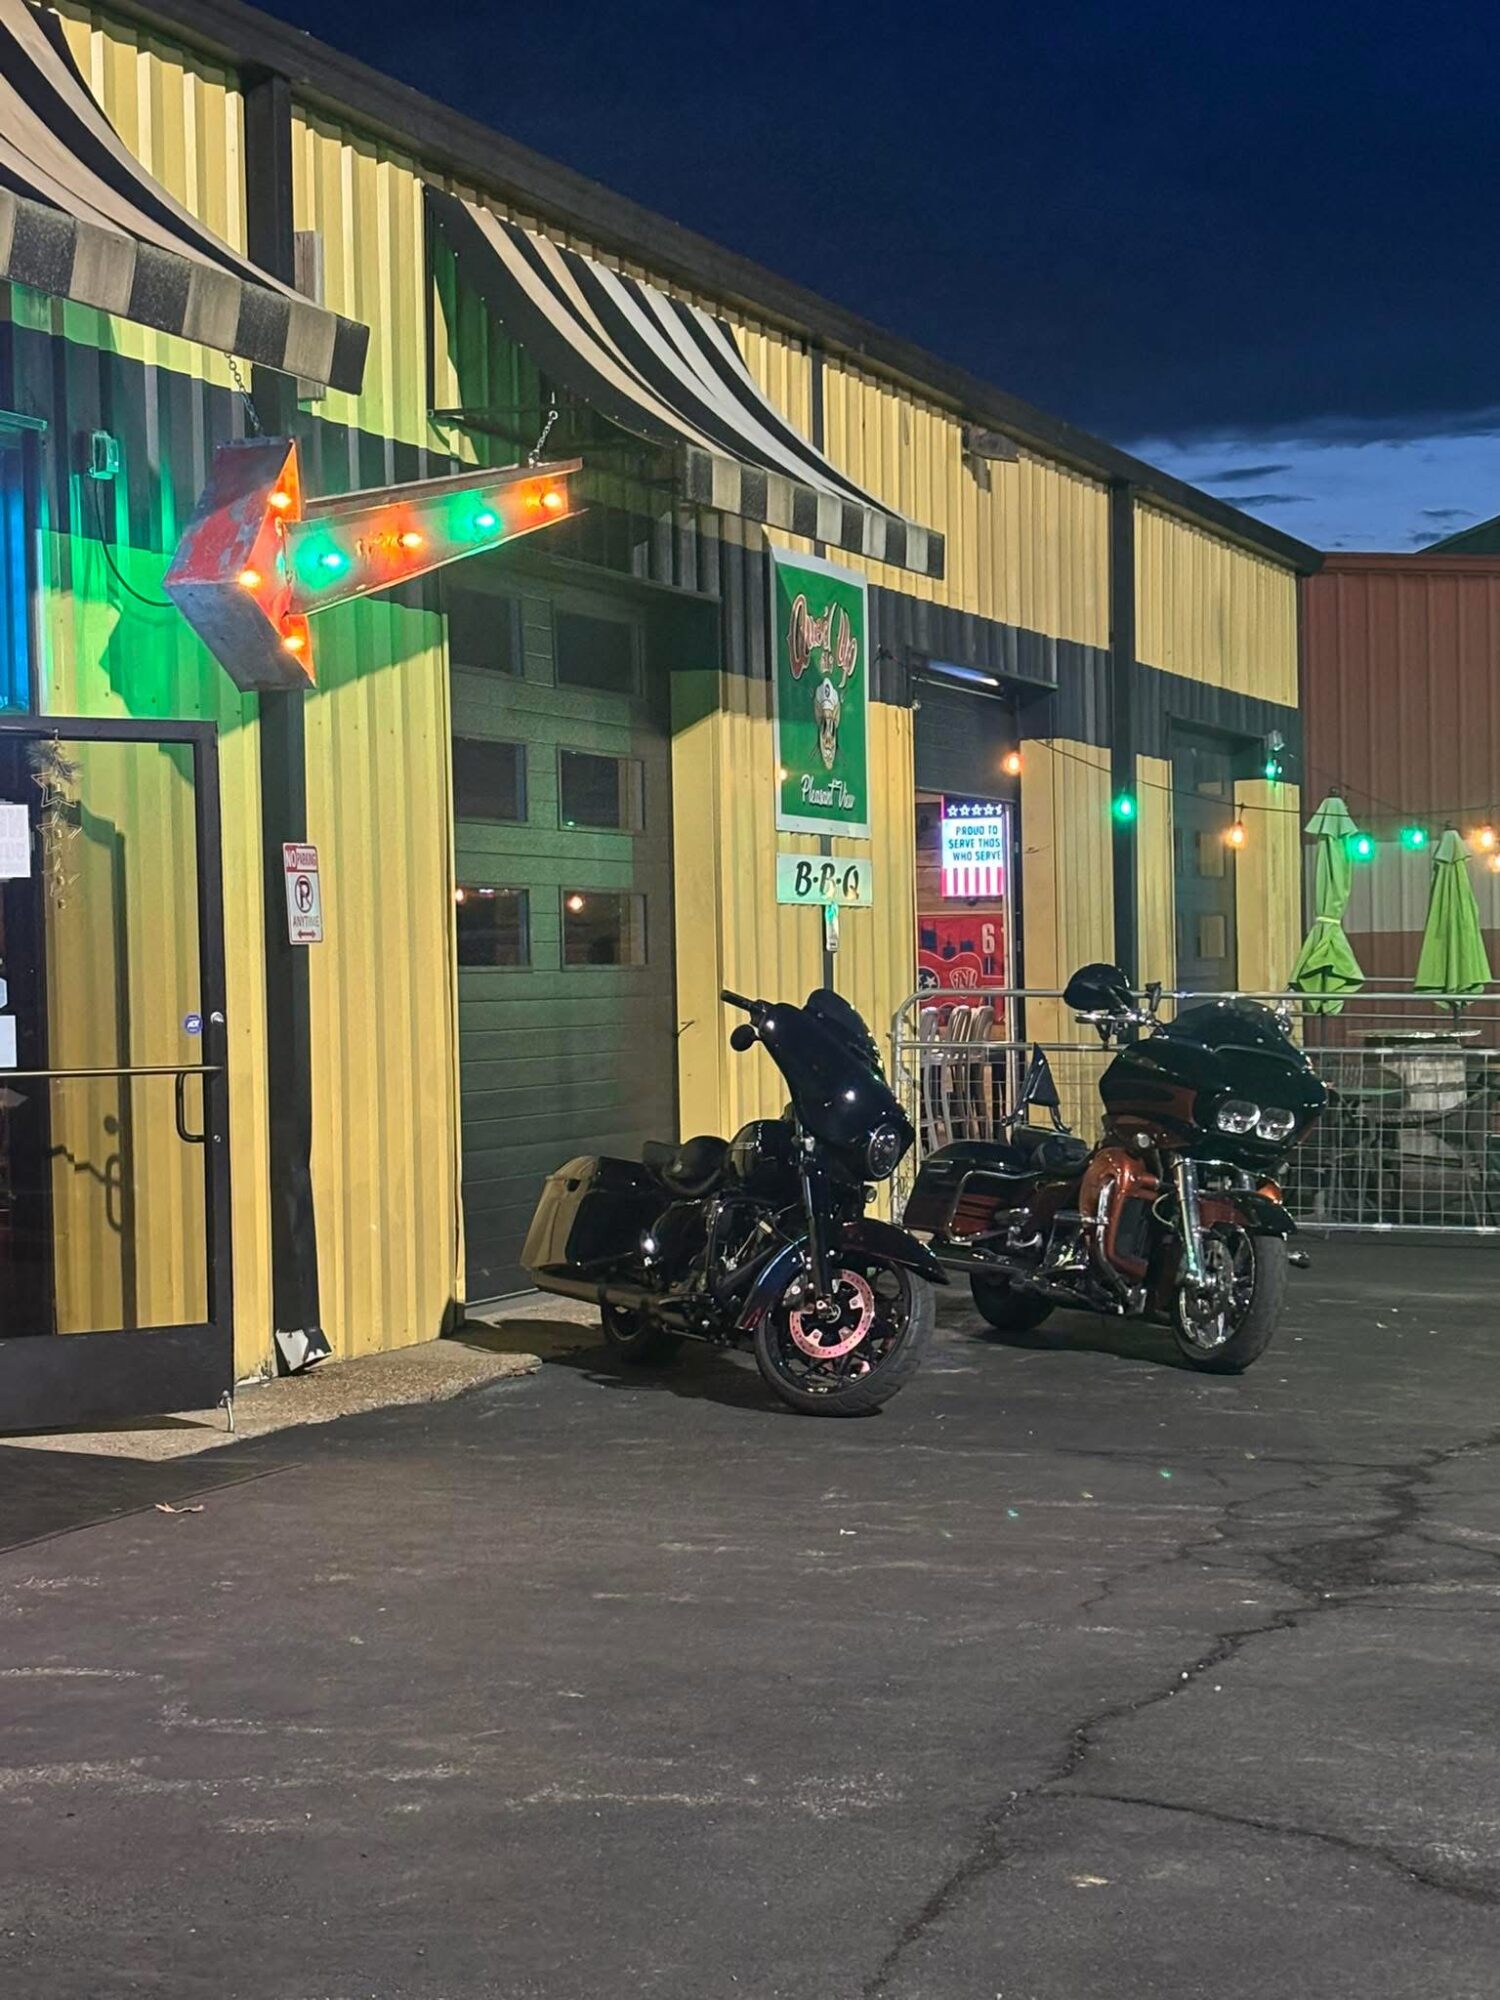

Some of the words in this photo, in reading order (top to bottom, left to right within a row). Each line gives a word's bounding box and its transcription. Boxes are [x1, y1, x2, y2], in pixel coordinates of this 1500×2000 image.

[800, 774, 836, 805] Pleasant
[835, 779, 856, 809] View
[955, 825, 985, 836] PROUD
[987, 824, 998, 835] TO
[948, 838, 975, 850] SERVE
[977, 837, 1001, 848] THOS
[286, 850, 296, 867] NO
[952, 850, 972, 861] WHO
[974, 850, 1001, 861] SERVE
